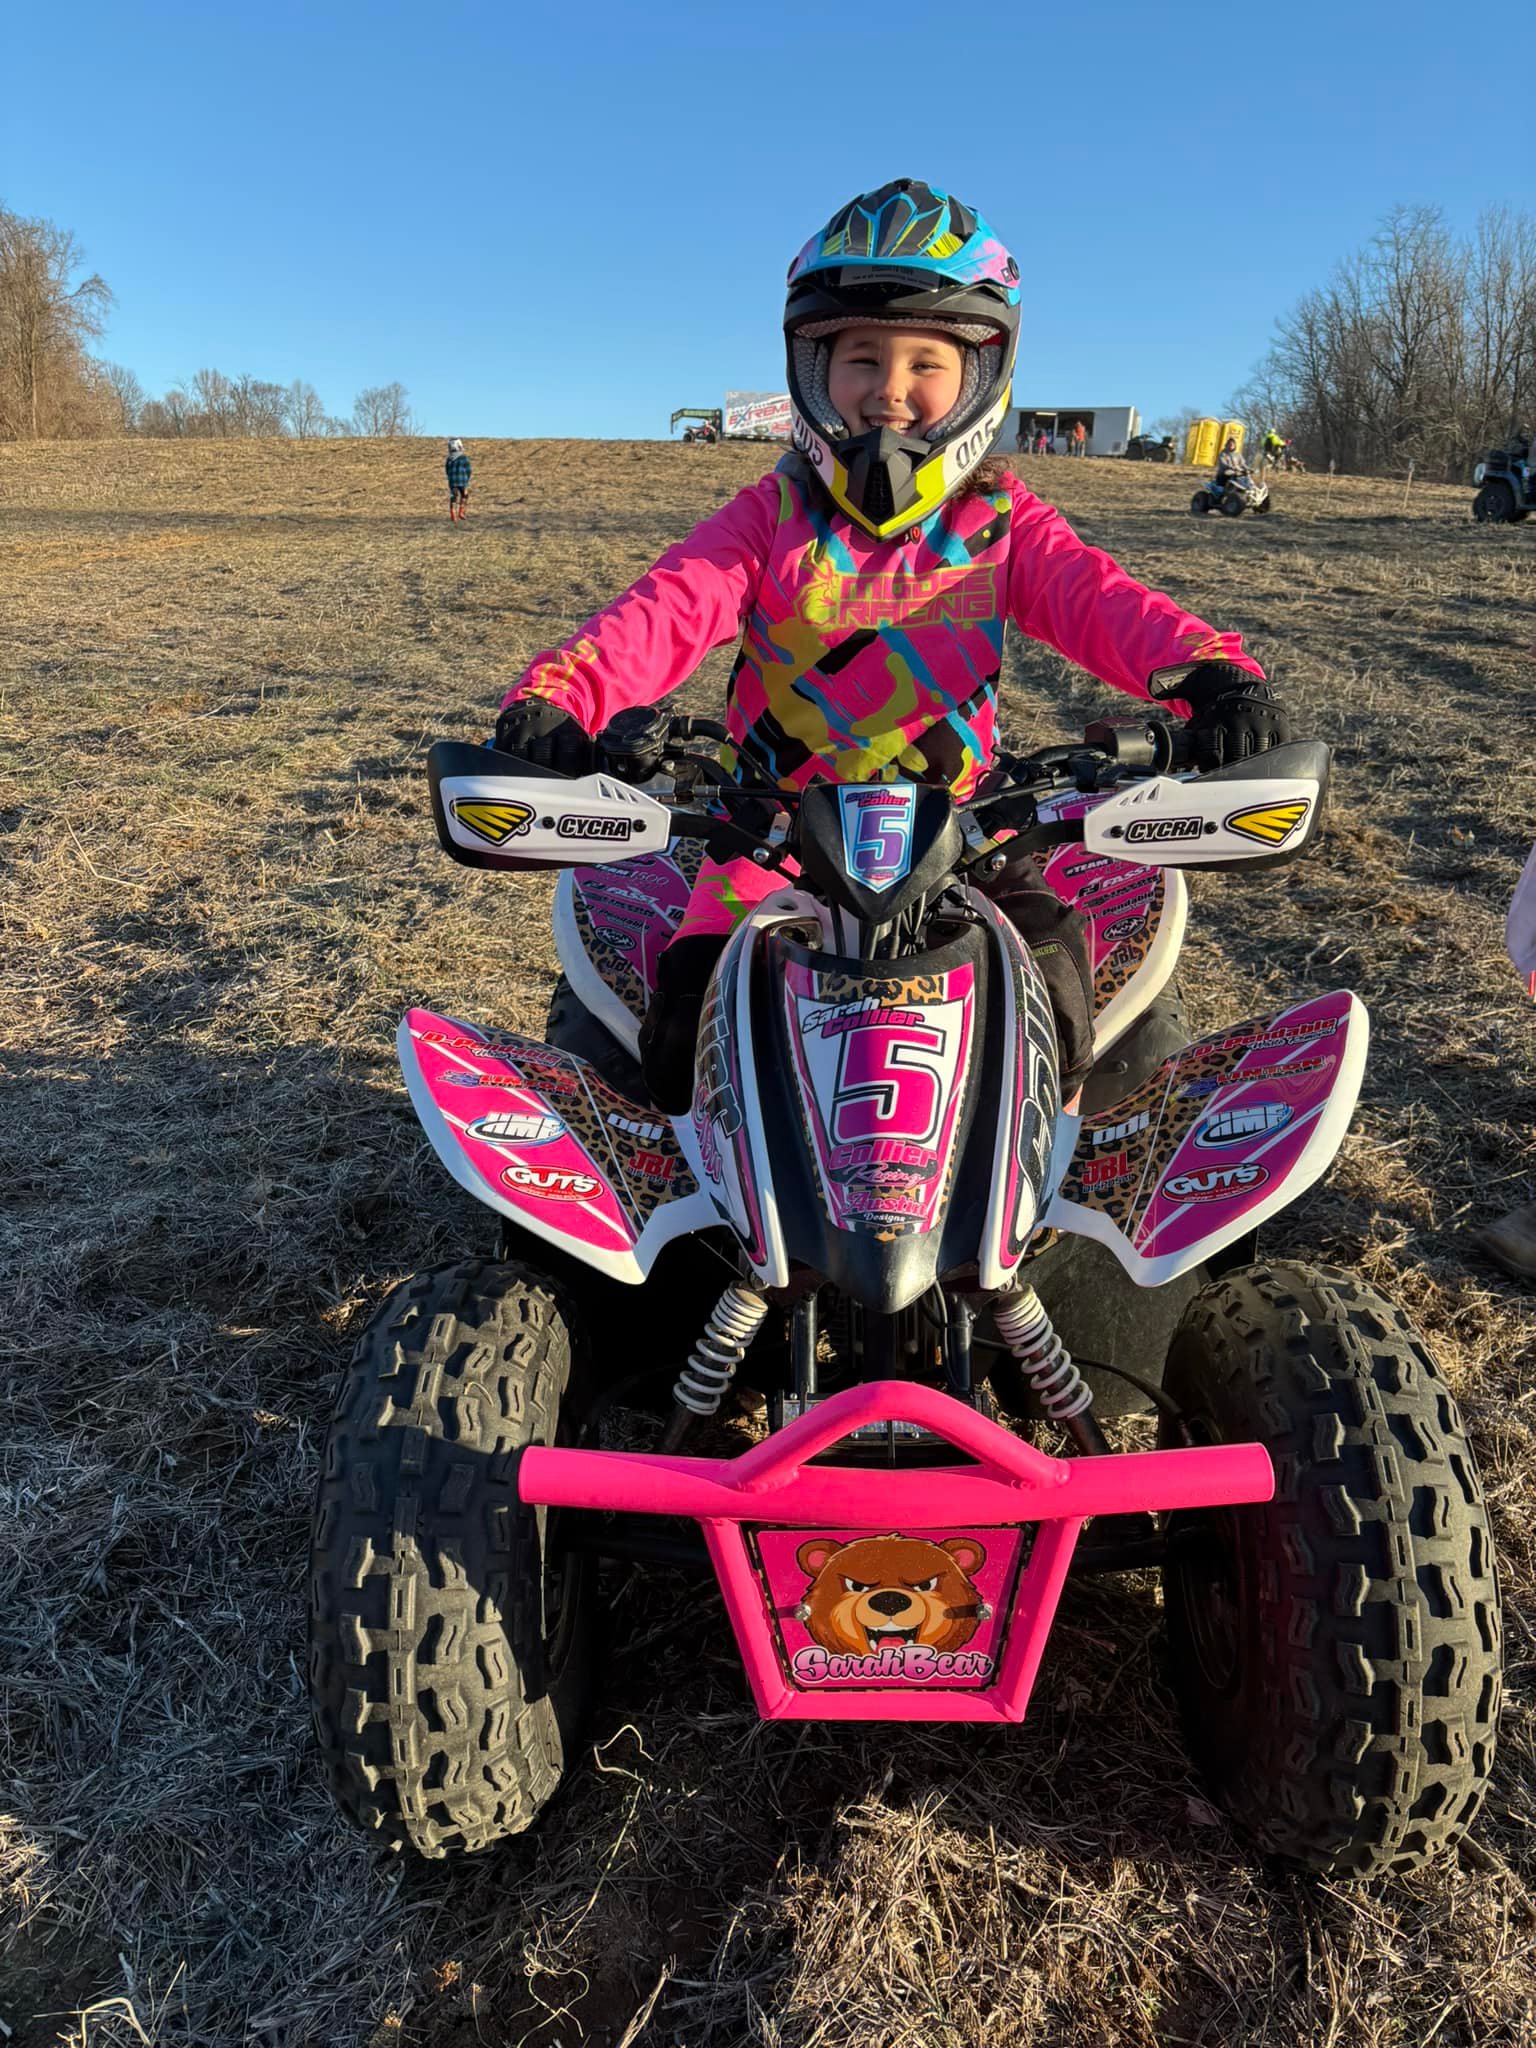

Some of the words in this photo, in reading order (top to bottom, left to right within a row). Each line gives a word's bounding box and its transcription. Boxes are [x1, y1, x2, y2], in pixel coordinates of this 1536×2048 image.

[840, 564, 996, 602] MOOSE
[840, 594, 995, 629] RACING
[562, 818, 628, 837] CYCRA
[853, 806, 910, 872] 5
[1130, 820, 1199, 840] CYCRA
[802, 996, 880, 1034] Sarah
[821, 1008, 925, 1039] Collier
[831, 1025, 947, 1145] 5
[482, 1112, 563, 1140] HMF
[1206, 1102, 1286, 1138] HMF
[628, 1151, 676, 1180] JBL
[829, 1139, 938, 1170] Collier
[1082, 1152, 1134, 1186] JBL
[505, 1166, 600, 1193] GUTS
[1164, 1165, 1258, 1195] GUTS
[841, 1191, 928, 1218] Austin
[793, 1645, 994, 1684] SarahBear
